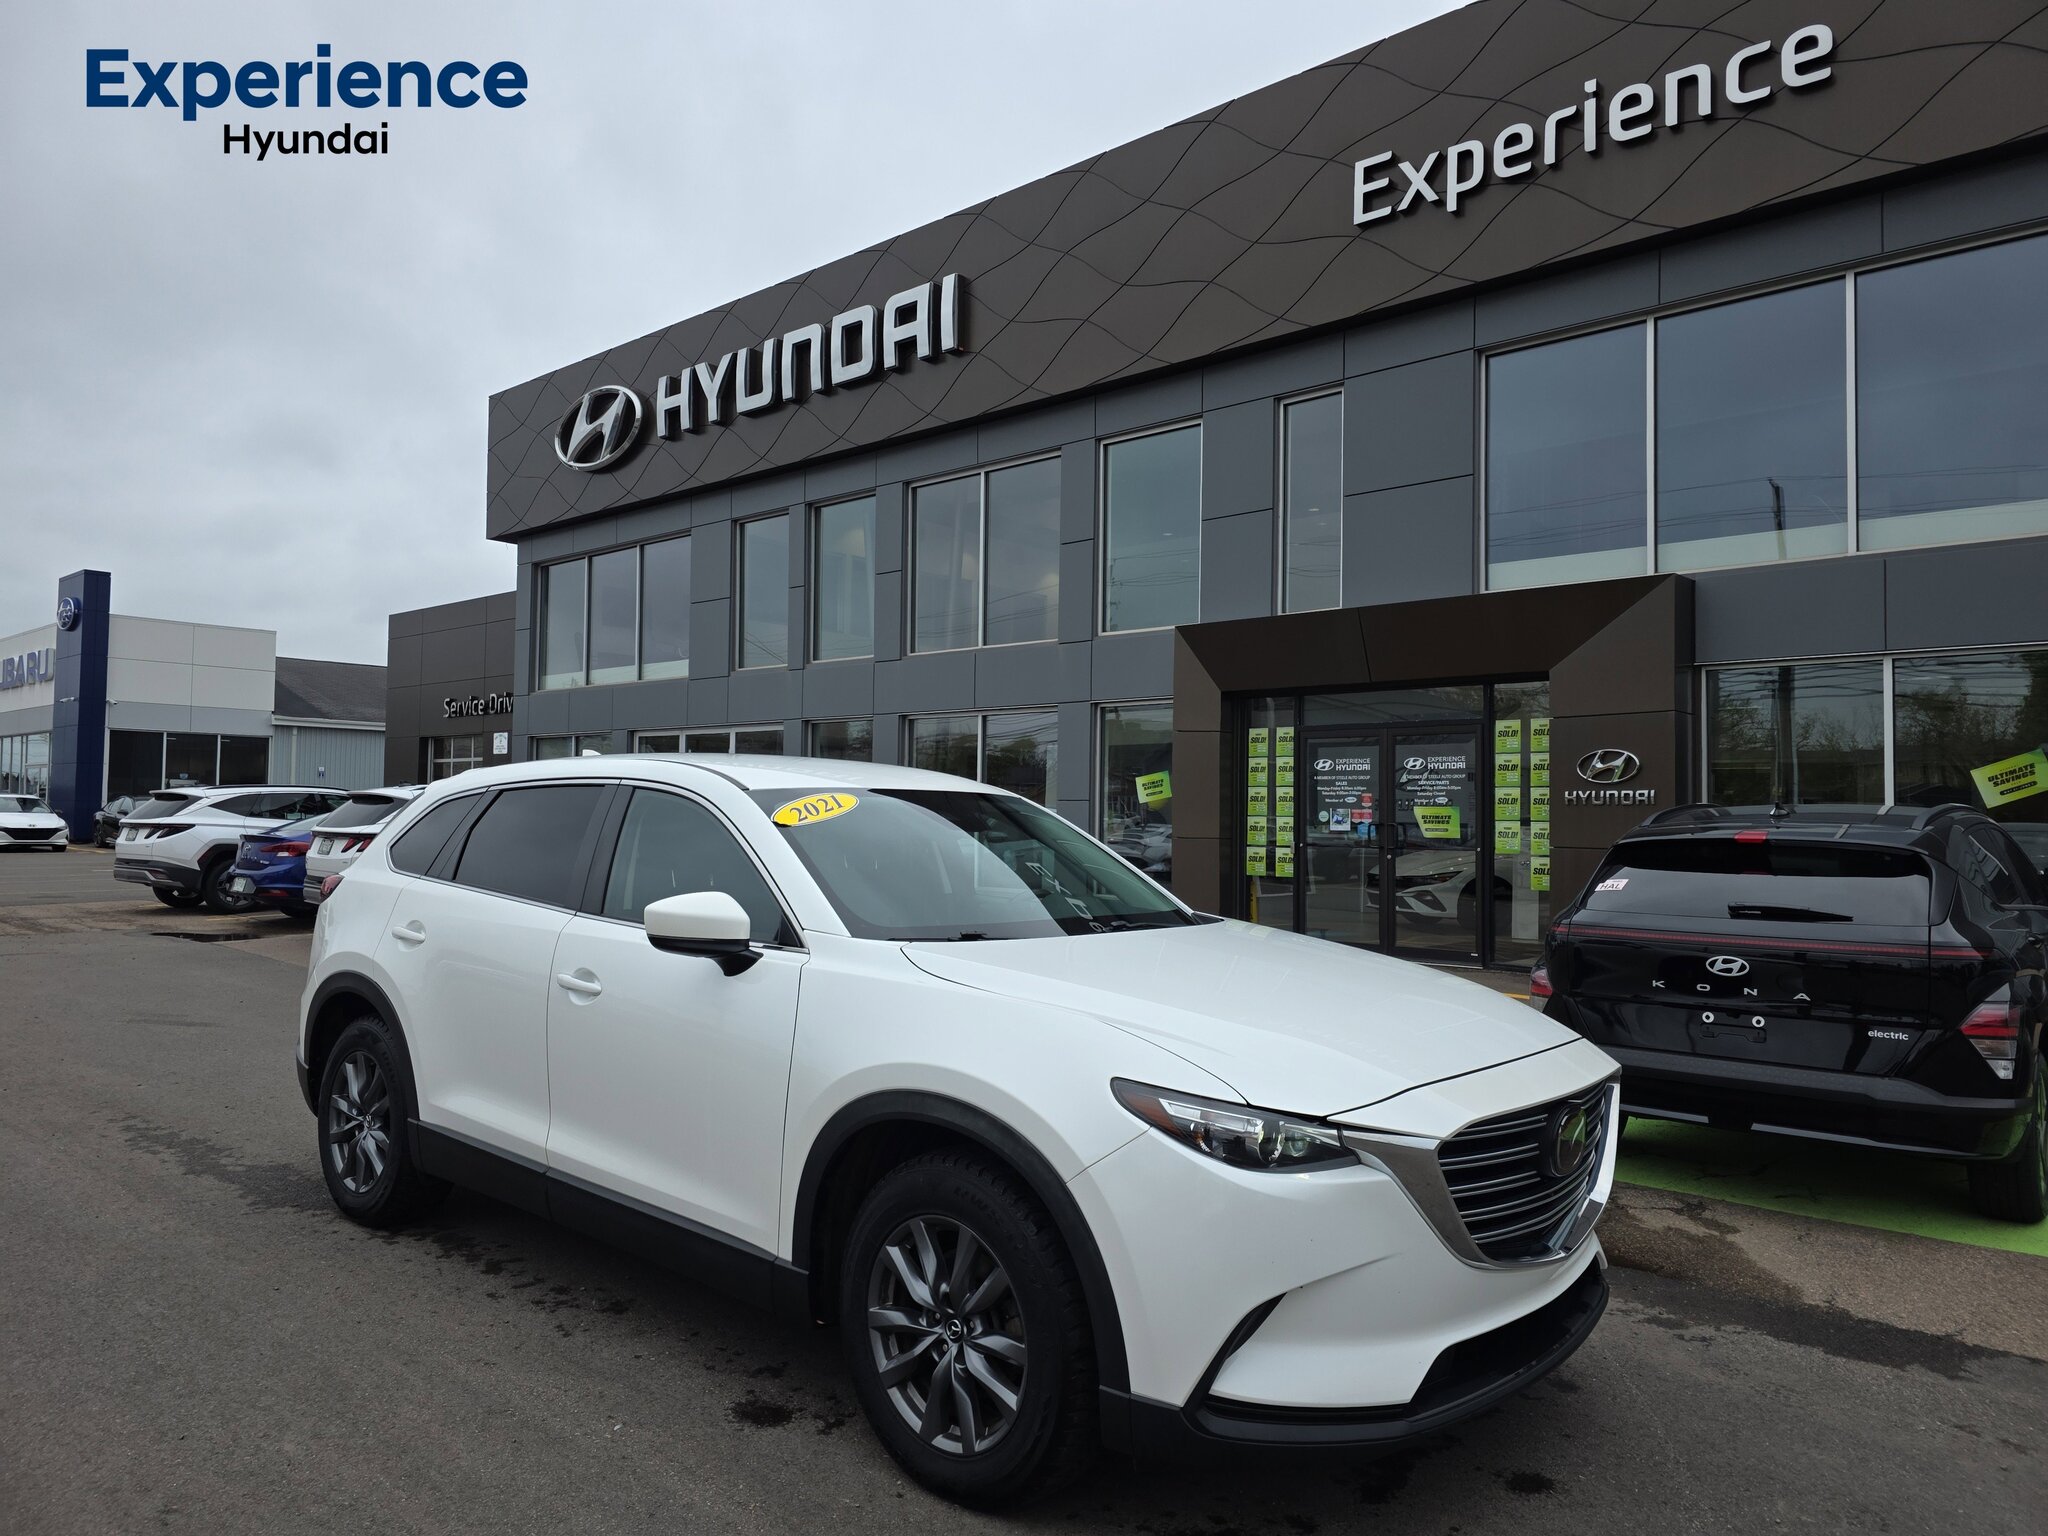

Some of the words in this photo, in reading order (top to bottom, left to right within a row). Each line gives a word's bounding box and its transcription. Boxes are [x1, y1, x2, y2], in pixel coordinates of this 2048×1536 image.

[1353, 24, 1834, 226] Experience
[657, 273, 963, 439] HYUNDAI
[443, 696, 485, 718] Service
[489, 692, 513, 713] Driv
[1988, 763, 2035, 782] ULTIMATE
[1993, 770, 2036, 787] SAVINGS
[790, 795, 845, 822] 2021
[1564, 790, 1655, 805] HYUNDAI
[1868, 1030, 1909, 1040] electric
